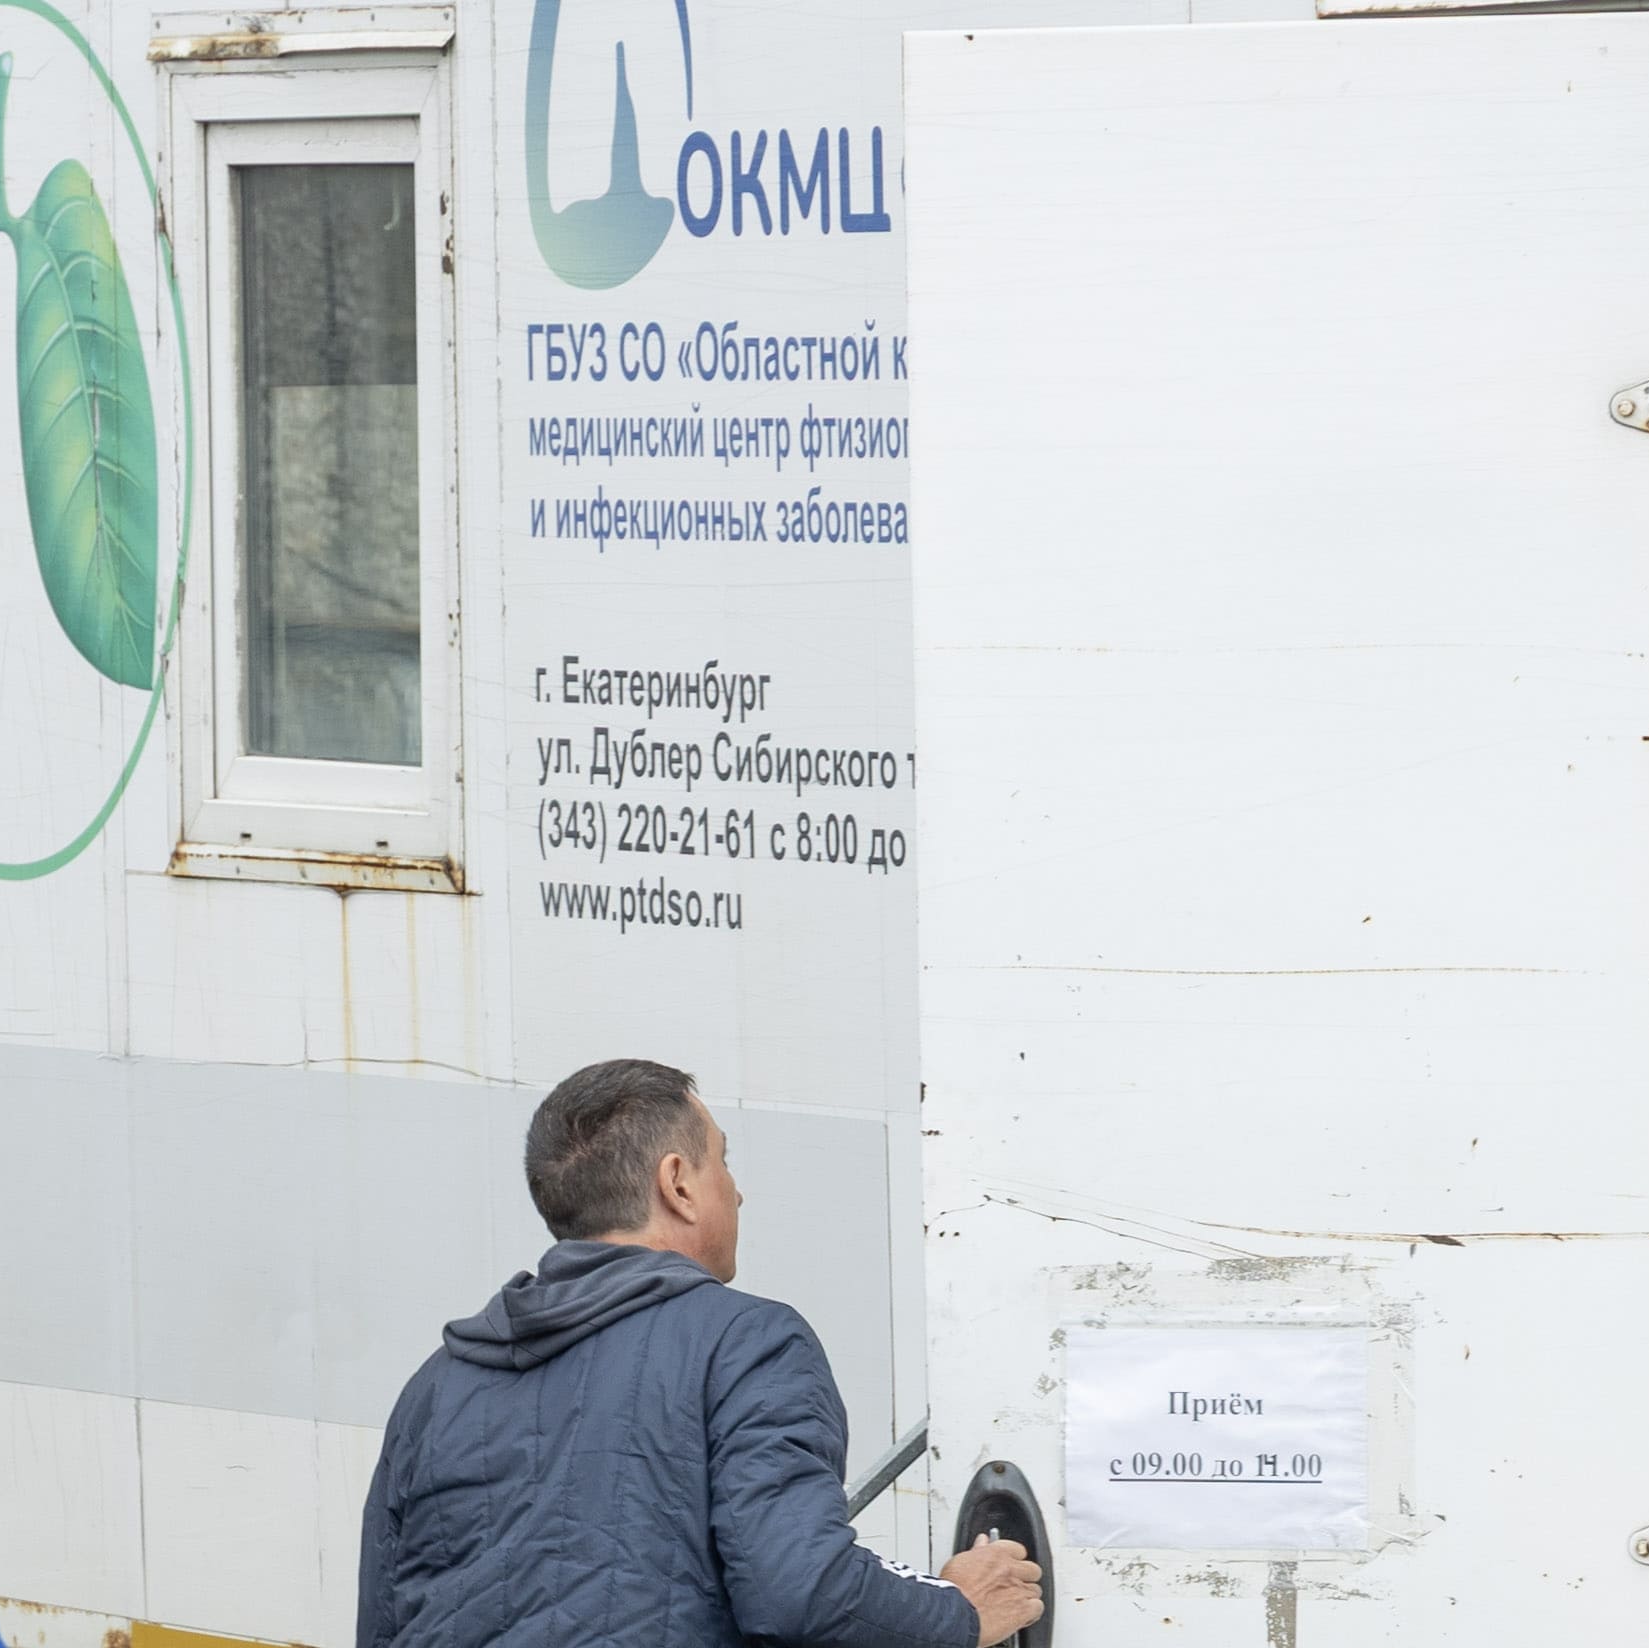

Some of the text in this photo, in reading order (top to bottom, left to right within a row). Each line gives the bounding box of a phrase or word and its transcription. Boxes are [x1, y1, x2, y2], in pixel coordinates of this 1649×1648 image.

[676, 125, 906, 238] ОКМЦ
[526, 322, 608, 383] ГБУЗ
[618, 321, 666, 383] СО
[677, 319, 881, 382] «Областной
[528, 402, 705, 467] медицинский
[713, 417, 791, 473] центр
[530, 484, 909, 554] и инфекционных заболева
[535, 655, 771, 724] г. Екатеринбург
[537, 737, 580, 787] ул.
[589, 726, 703, 793] Дублер
[711, 731, 897, 798] Сибирского
[537, 798, 907, 876] (343) 220-21-61 с 8:00 до
[539, 875, 743, 935] www.ptdso.ru
[1167, 1391, 1263, 1422] Приём
[1109, 1458, 1123, 1476] с
[1132, 1452, 1203, 1477] 09.00
[1211, 1459, 1243, 1479] до
